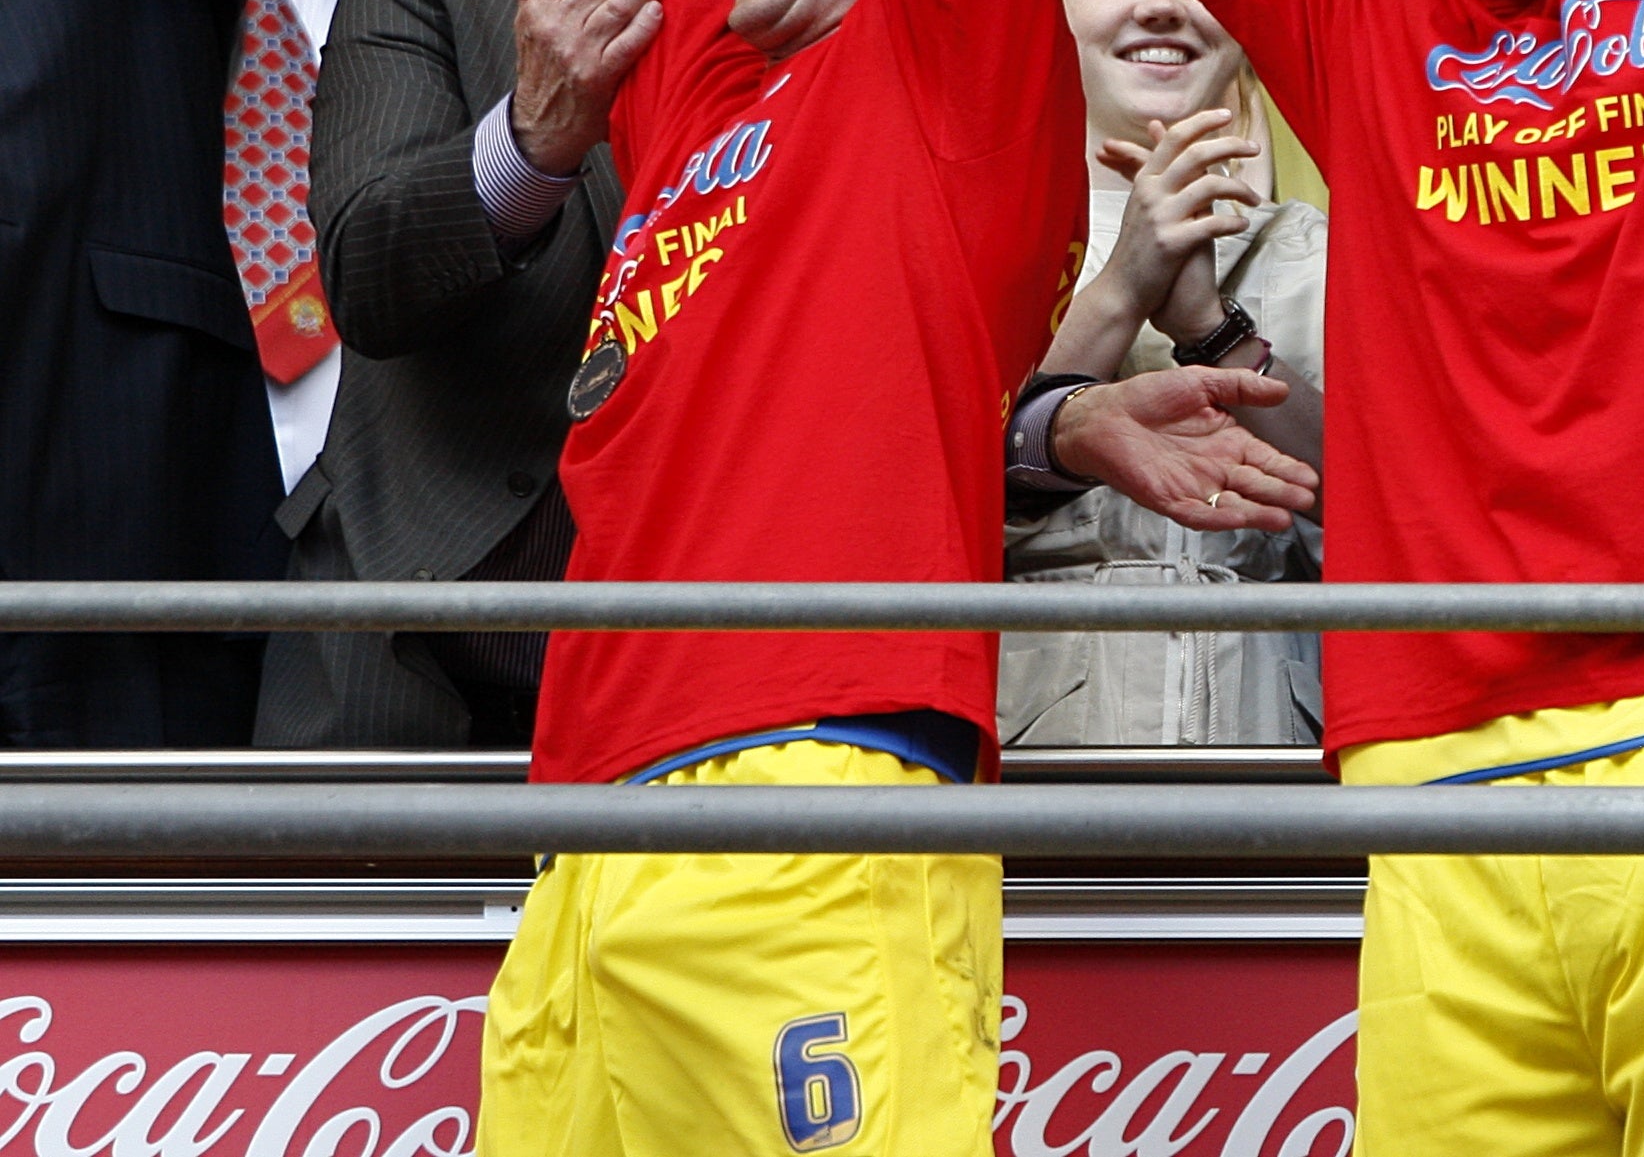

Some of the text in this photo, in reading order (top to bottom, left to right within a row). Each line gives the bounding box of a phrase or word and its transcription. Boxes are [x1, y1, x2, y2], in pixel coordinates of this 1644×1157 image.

[1436, 111, 1509, 150] PLAY
[1513, 107, 1586, 145] OFF
[655, 195, 748, 266] FINAL
[773, 1011, 862, 1154] 6
